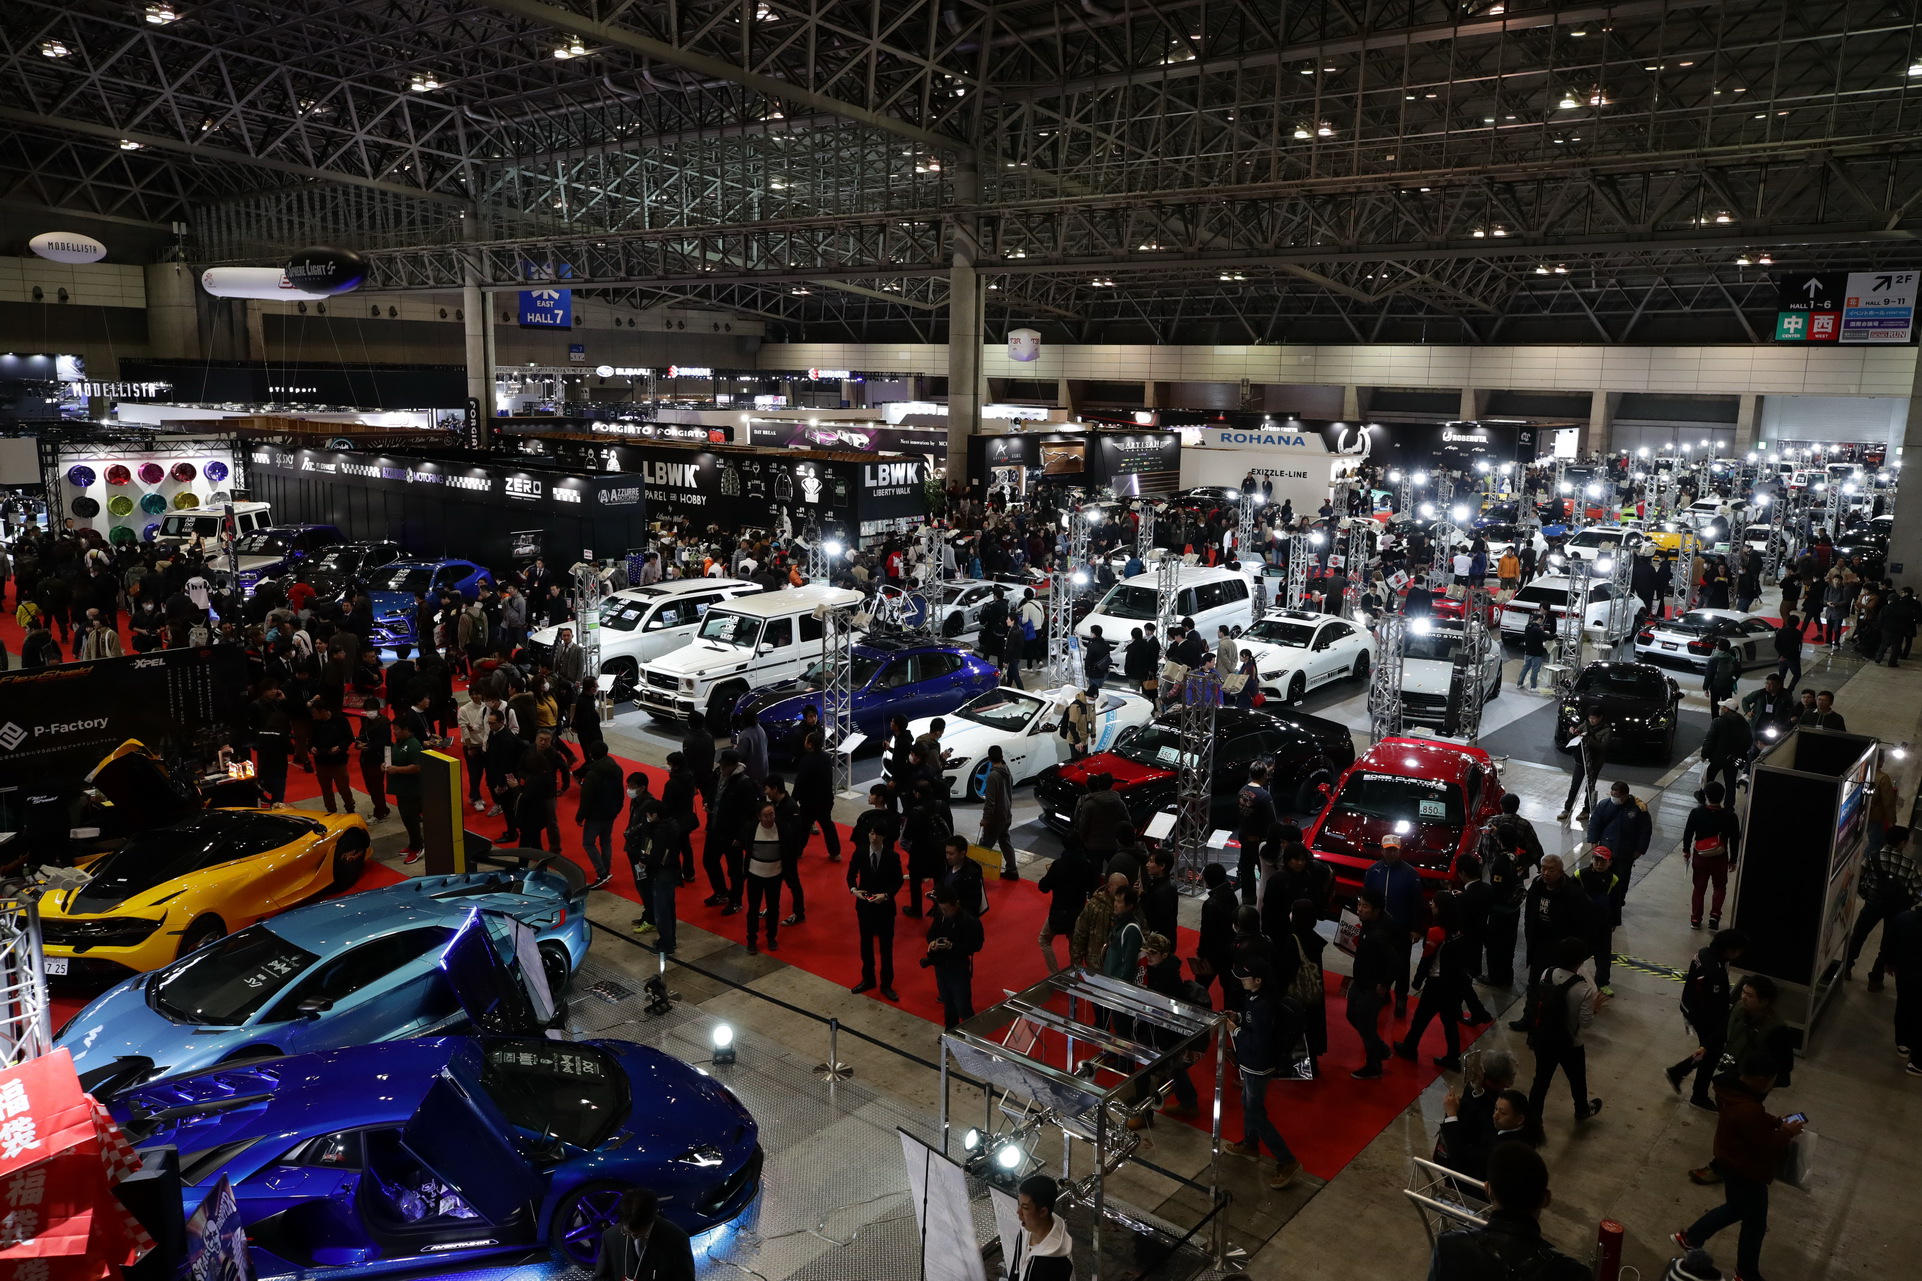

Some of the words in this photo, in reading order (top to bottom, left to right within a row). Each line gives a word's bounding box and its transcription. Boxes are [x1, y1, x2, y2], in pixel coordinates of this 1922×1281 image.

[47, 241, 97, 254] MODELLISTA
[1895, 274, 1913, 284] 2F
[536, 300, 555, 308] EAST
[527, 312, 553, 324] HALL
[554, 309, 564, 324] 7
[1783, 315, 1803, 334] 中
[1813, 315, 1835, 333] 西
[615, 367, 651, 376] SUBARU
[71, 382, 156, 398] MODELLISTA
[591, 422, 653, 435] FORGIATO
[657, 428, 708, 438] FORGIATO
[1125, 440, 1160, 449] ARTISAN
[1220, 432, 1306, 447] ROHANA
[413, 471, 444, 484] MOTORING
[642, 460, 698, 488] LBWK
[864, 462, 920, 487] LBWK
[1251, 468, 1308, 479] EXIZZLE-LINE
[505, 477, 542, 494] ZERO
[873, 488, 895, 497] LIBERTY
[895, 487, 911, 495] WALK
[679, 493, 707, 505] HOBBY
[135, 658, 166, 669] XPEL
[34, 717, 109, 737] P-Factory
[1422, 805, 1439, 815] 850
[0, 1078, 42, 1159] 福袋
[1, 1168, 47, 1249] 福袋
